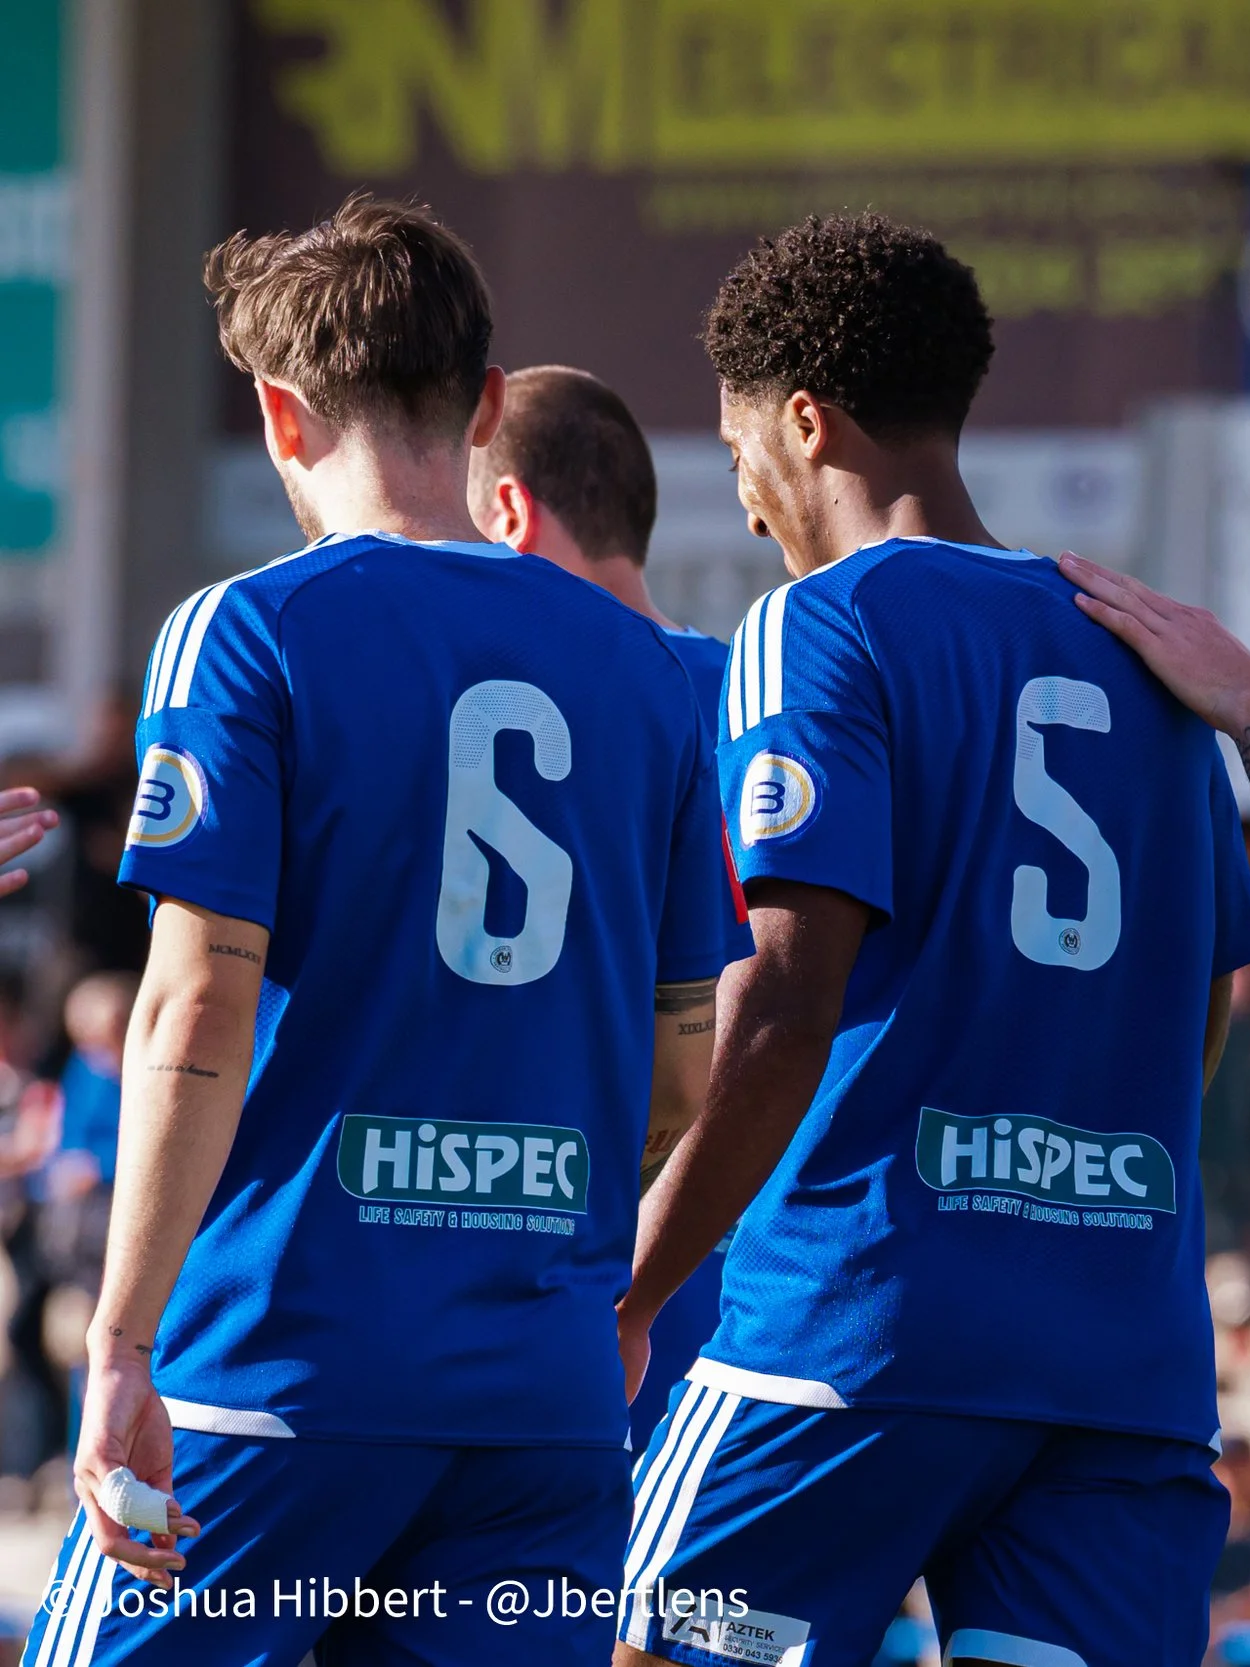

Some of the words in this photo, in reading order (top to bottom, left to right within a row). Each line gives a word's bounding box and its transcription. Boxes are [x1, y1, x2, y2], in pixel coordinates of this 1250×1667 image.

[436, 680, 572, 985] 6
[1011, 676, 1121, 971] 5
[363, 1123, 578, 1200] HiSPEC
[941, 1118, 1148, 1198] HiSPEC
[359, 1205, 390, 1223] LIFE
[394, 1207, 445, 1228] SAFETY
[462, 1211, 523, 1231] HOUSING
[526, 1214, 576, 1236] SOLUTIONS
[938, 1195, 968, 1211] LIFE
[972, 1194, 1022, 1216] SAFETY
[1030, 1205, 1080, 1226] HOUSING
[1083, 1212, 1153, 1230] SOLUTIONS
[723, 1643, 743, 1655] 0330
[745, 1648, 761, 1659] 043
[726, 1621, 775, 1641] AZTEK
